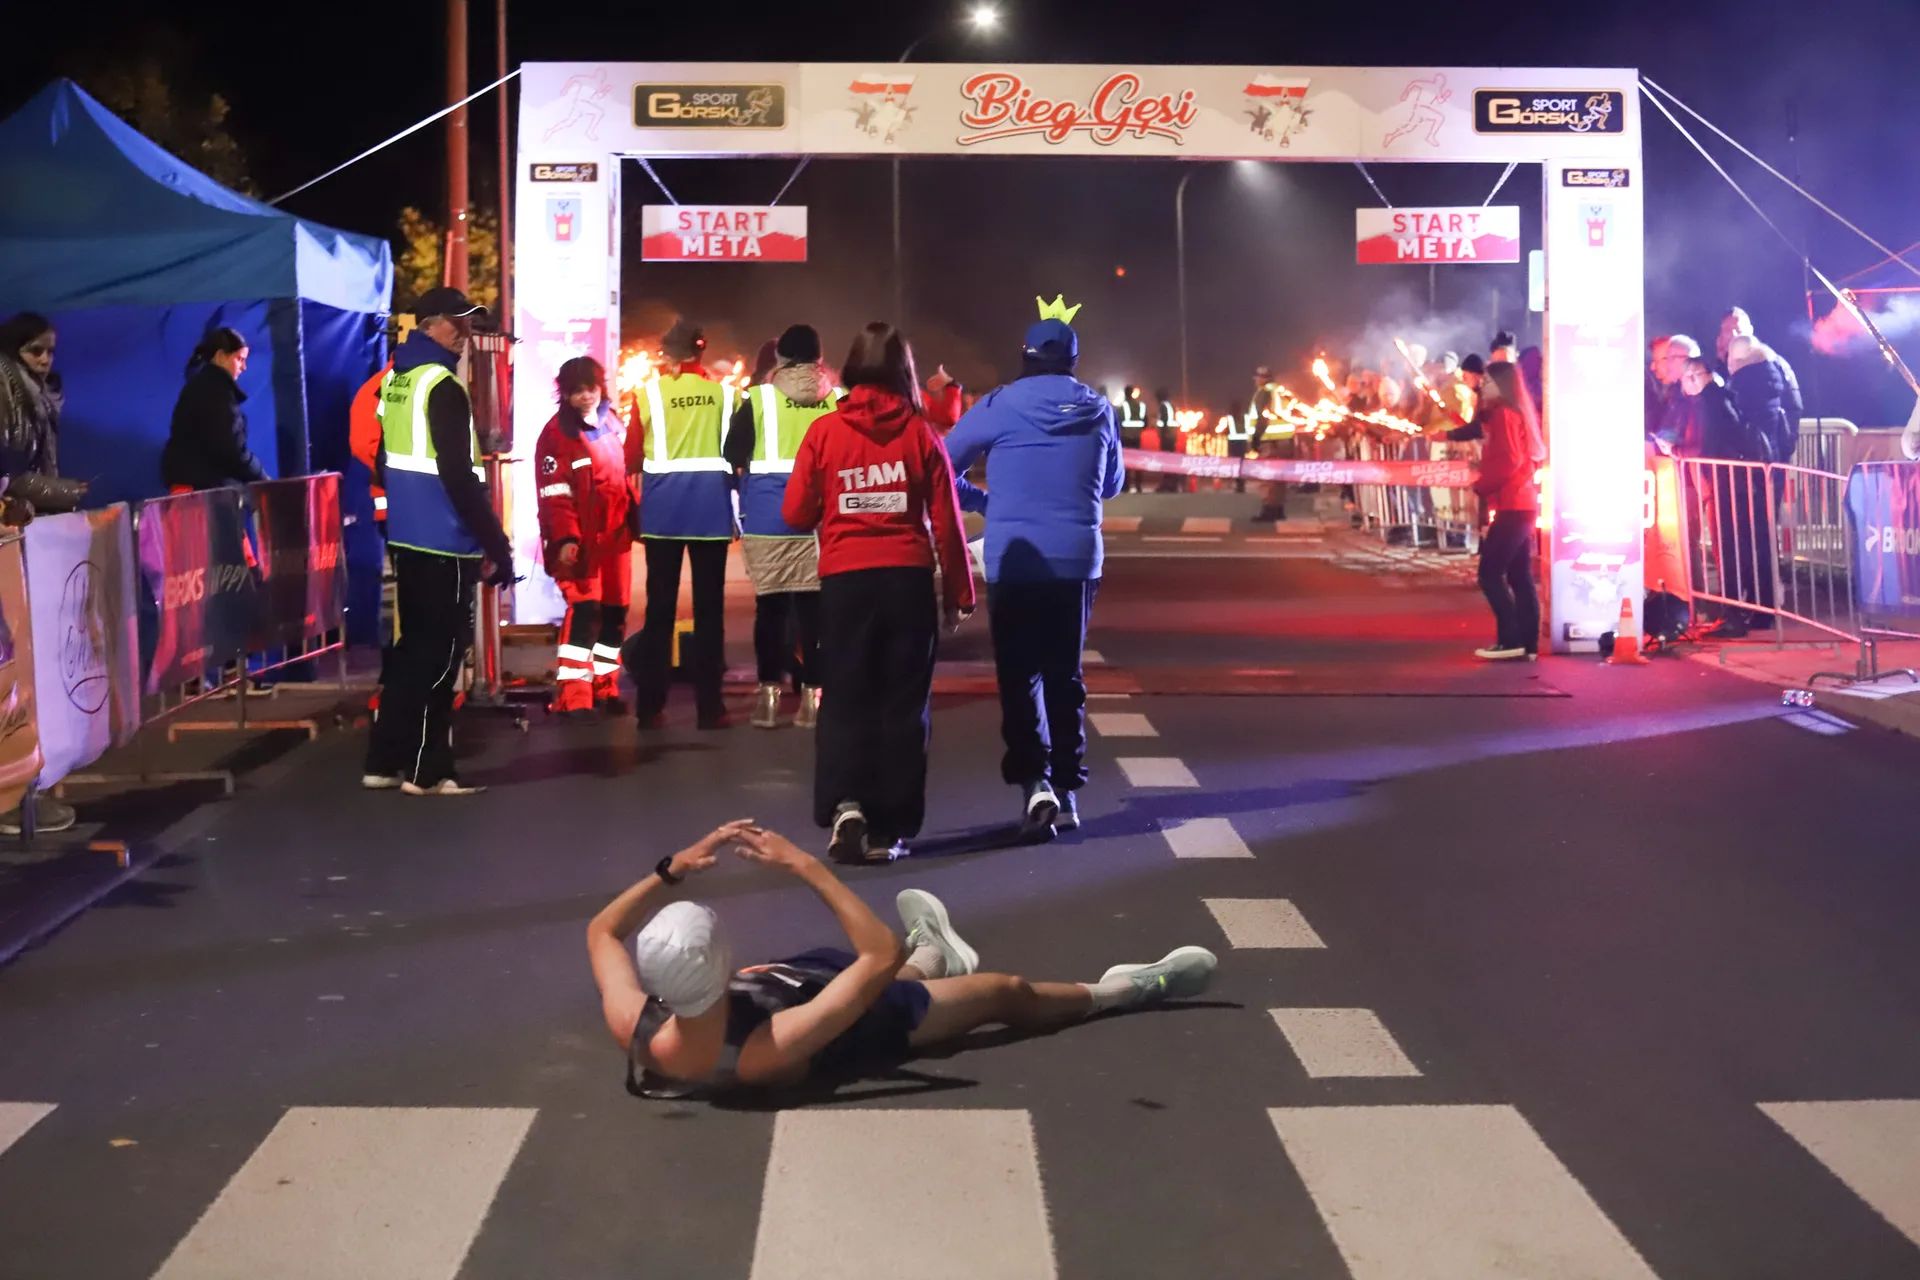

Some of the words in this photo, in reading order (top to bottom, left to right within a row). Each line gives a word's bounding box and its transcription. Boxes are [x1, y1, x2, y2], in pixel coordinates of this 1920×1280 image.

[648, 92, 740, 119] GÓRSKI
[692, 93, 738, 106] SPORT
[961, 72, 1086, 142] Bieg
[1532, 98, 1578, 112] SPORT
[1488, 98, 1579, 125] GÓRSKI
[678, 211, 769, 232] START
[1392, 213, 1481, 233] START
[681, 235, 763, 257] META
[1397, 237, 1477, 260] META
[670, 395, 716, 411] SĘDZIA
[837, 460, 907, 492] TEAM
